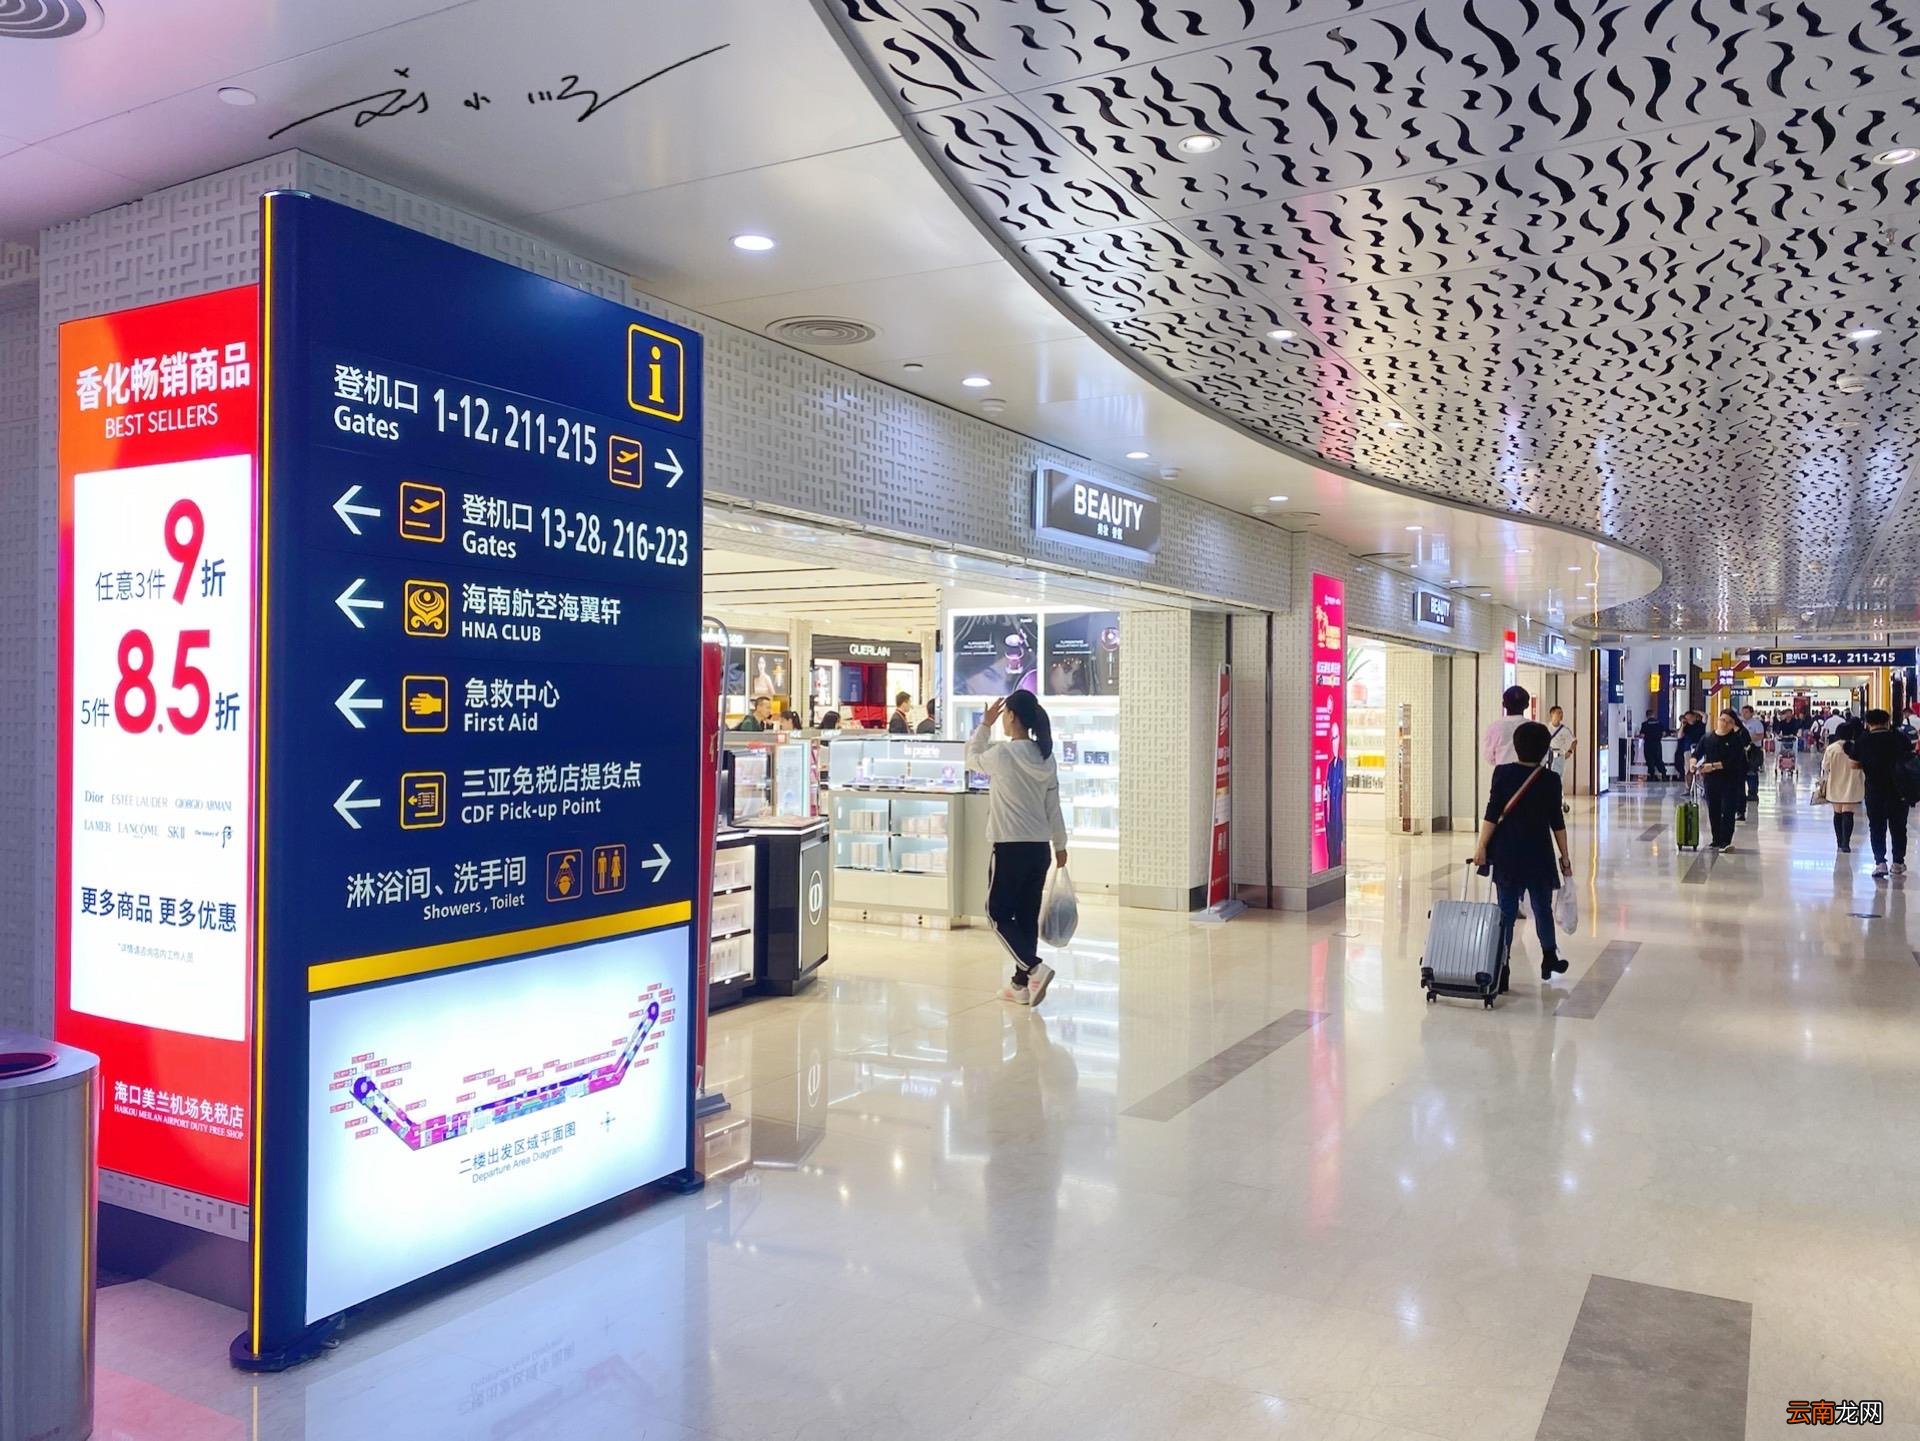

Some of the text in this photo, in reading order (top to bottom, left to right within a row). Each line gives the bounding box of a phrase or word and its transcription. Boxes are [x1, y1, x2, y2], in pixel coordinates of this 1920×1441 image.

[75, 341, 250, 411] 香化畅销商品
[105, 402, 218, 439] BEST SELLERS
[333, 404, 400, 441] Gates
[334, 364, 418, 414] 登机口
[504, 404, 597, 465] 211-215
[1074, 483, 1143, 531] BEAUTY
[462, 493, 533, 533] 登机口
[613, 518, 688, 567] 216-223
[462, 530, 517, 559] Gates
[461, 583, 621, 626] 海南航空海翼轩
[461, 621, 541, 642] HNA CLUB
[849, 643, 891, 657] GUERLAIN
[1847, 652, 1896, 663] 211-215
[465, 677, 560, 710] 急救中心
[1675, 678, 1685, 686] 12
[464, 712, 538, 732] First Aid
[85, 790, 104, 803] Dior
[461, 761, 641, 798] 三亚免税店提货点
[461, 797, 601, 824] CDF Pick-up Point
[346, 856, 527, 909] 淋浴间、洗手间
[81, 886, 237, 932] 更多商品 更多优惠
[114, 1080, 244, 1129] 海口美兰机场免税店
[114, 1104, 244, 1140] HAIKOU MEILAN AIRPORT DUTY FREE SHOP
[459, 1121, 576, 1174] 二楼出发区域平面图
[472, 1145, 563, 1183] Departure Area Diagram
